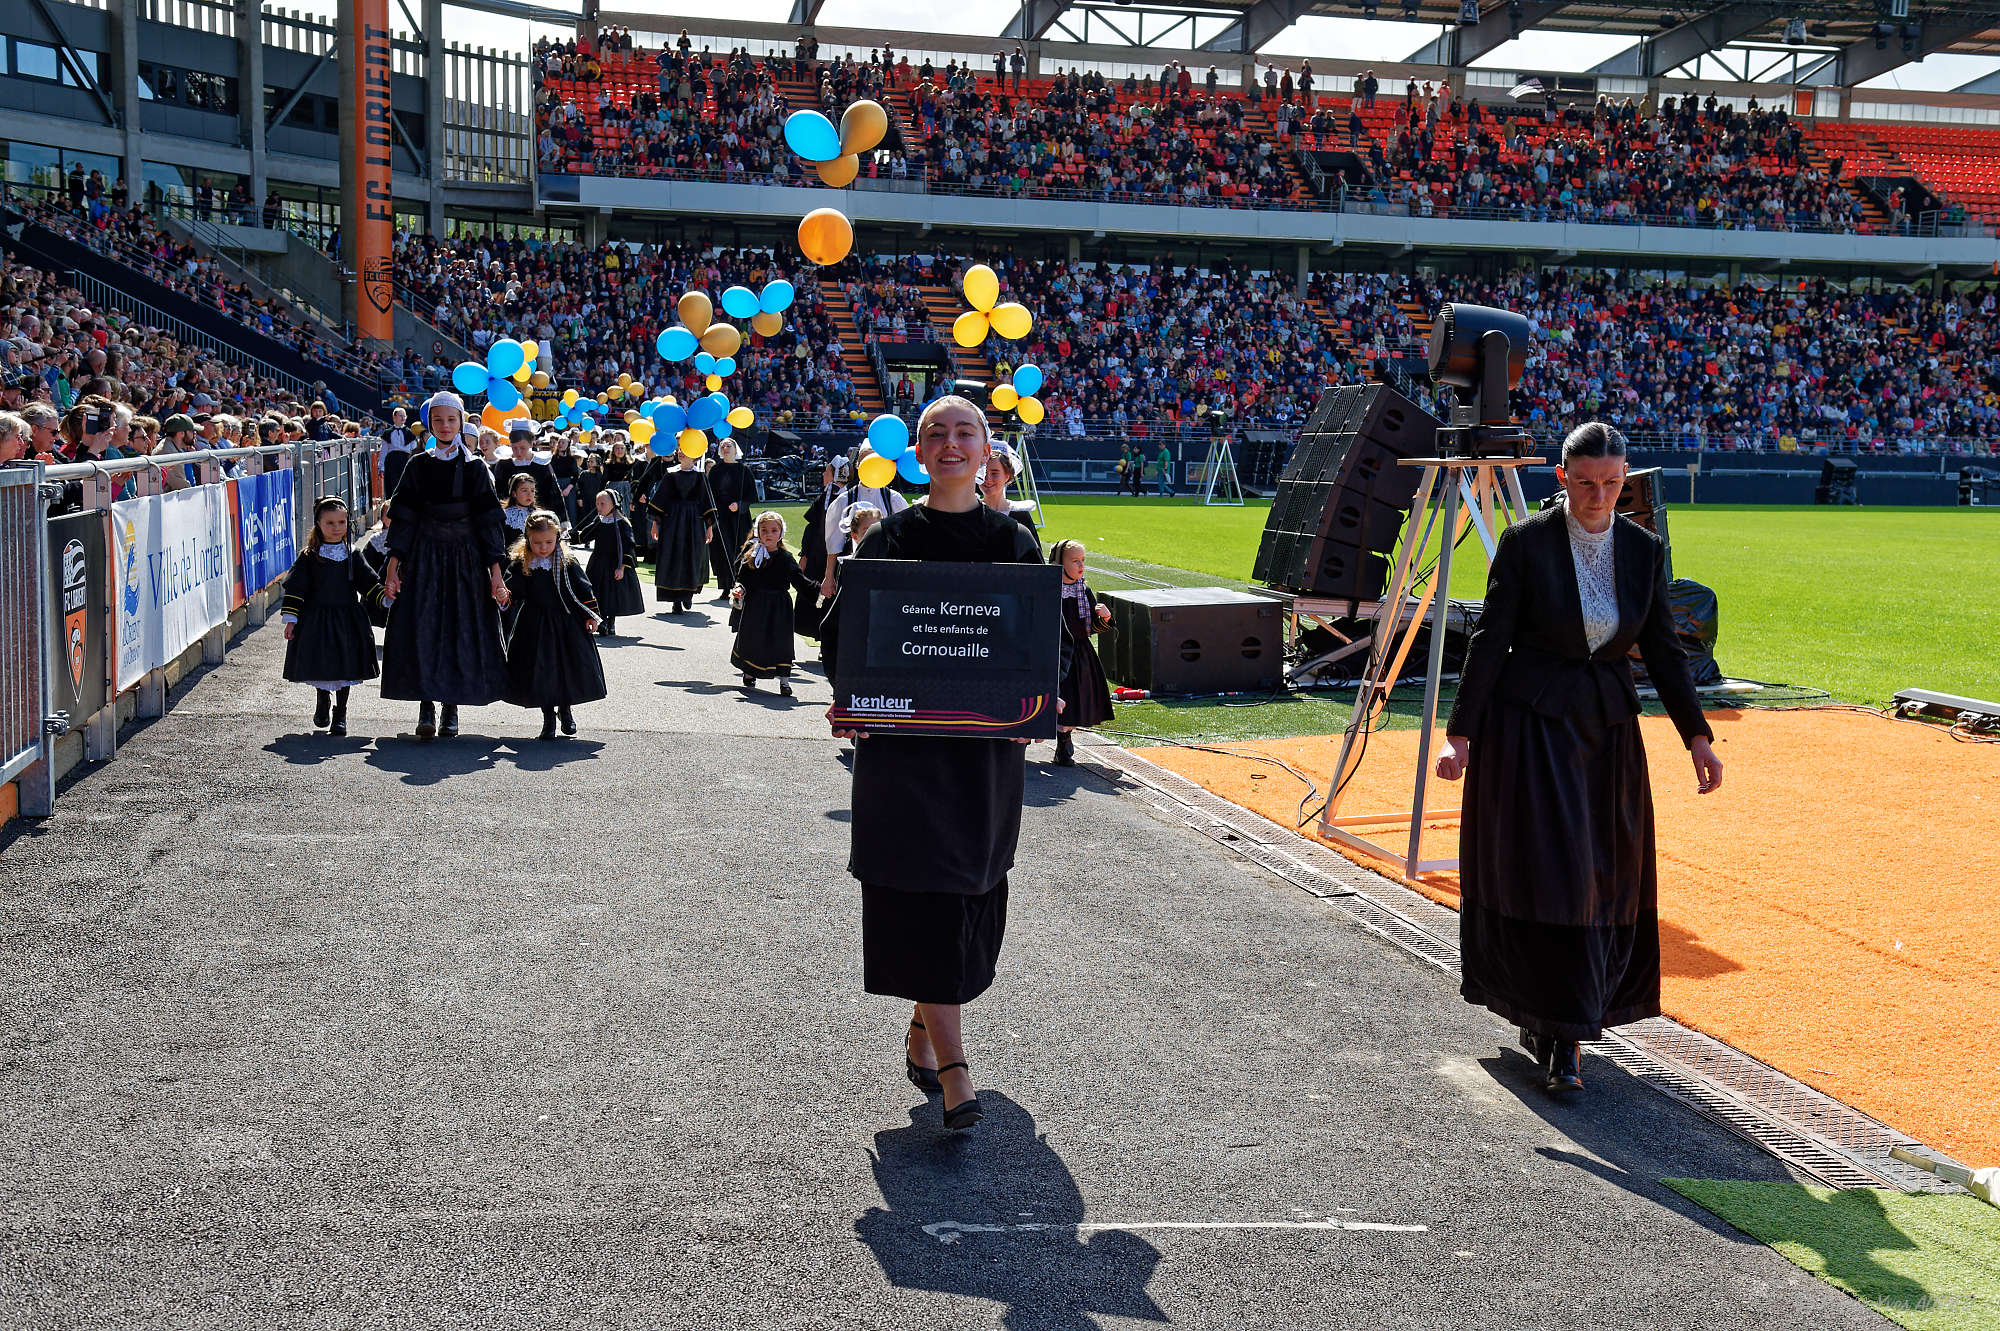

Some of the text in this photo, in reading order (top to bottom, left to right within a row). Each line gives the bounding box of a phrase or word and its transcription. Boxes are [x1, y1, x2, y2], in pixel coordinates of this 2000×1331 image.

[365, 24, 392, 222] FC LORIENT
[148, 546, 178, 611] Ville
[181, 539, 191, 595] de
[902, 602, 1001, 616] Géante Kerneva
[912, 624, 989, 635] et les enfants de
[901, 641, 989, 658] Cornouaille
[851, 694, 913, 711] kenleur
